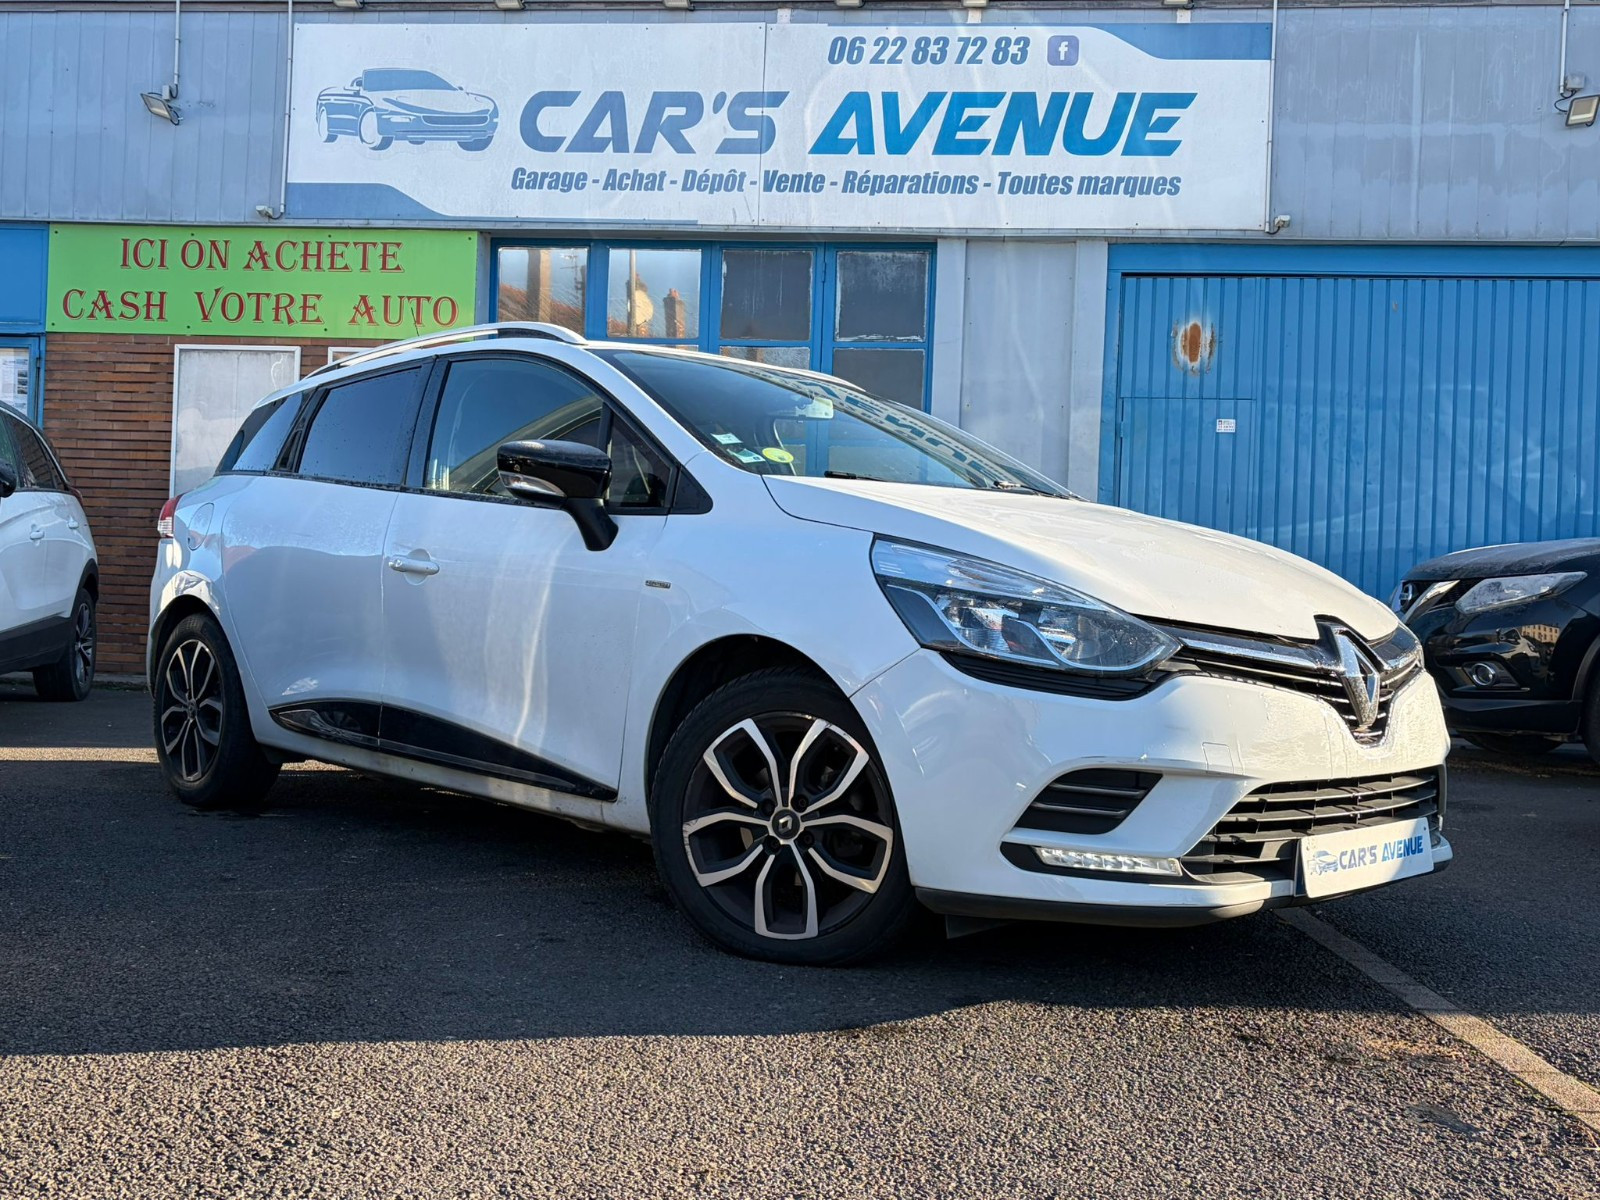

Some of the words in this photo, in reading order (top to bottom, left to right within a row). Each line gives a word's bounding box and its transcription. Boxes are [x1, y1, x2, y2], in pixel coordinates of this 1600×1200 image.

[828, 36, 867, 65] 06
[869, 36, 908, 65] 22
[911, 36, 950, 65] 83
[954, 36, 989, 66] 72
[991, 36, 1031, 66] 83
[519, 90, 790, 155] CAR'S
[807, 90, 1199, 157] AVENUE
[510, 167, 588, 193] Garage
[601, 168, 667, 192] Achat
[680, 168, 747, 195] Dépôt
[762, 170, 826, 194] Vente
[841, 169, 980, 197] Réparations
[997, 171, 1074, 196] Toutes
[1076, 176, 1182, 199] marques
[120, 238, 169, 270] ICI
[180, 239, 231, 271] ON
[243, 240, 405, 273] ACHETE
[62, 288, 168, 322] CASH
[194, 286, 324, 326] VOTRE
[347, 294, 459, 328] AUTO
[1339, 845, 1377, 870] CAR'S
[1381, 836, 1423, 862] AVENUE
